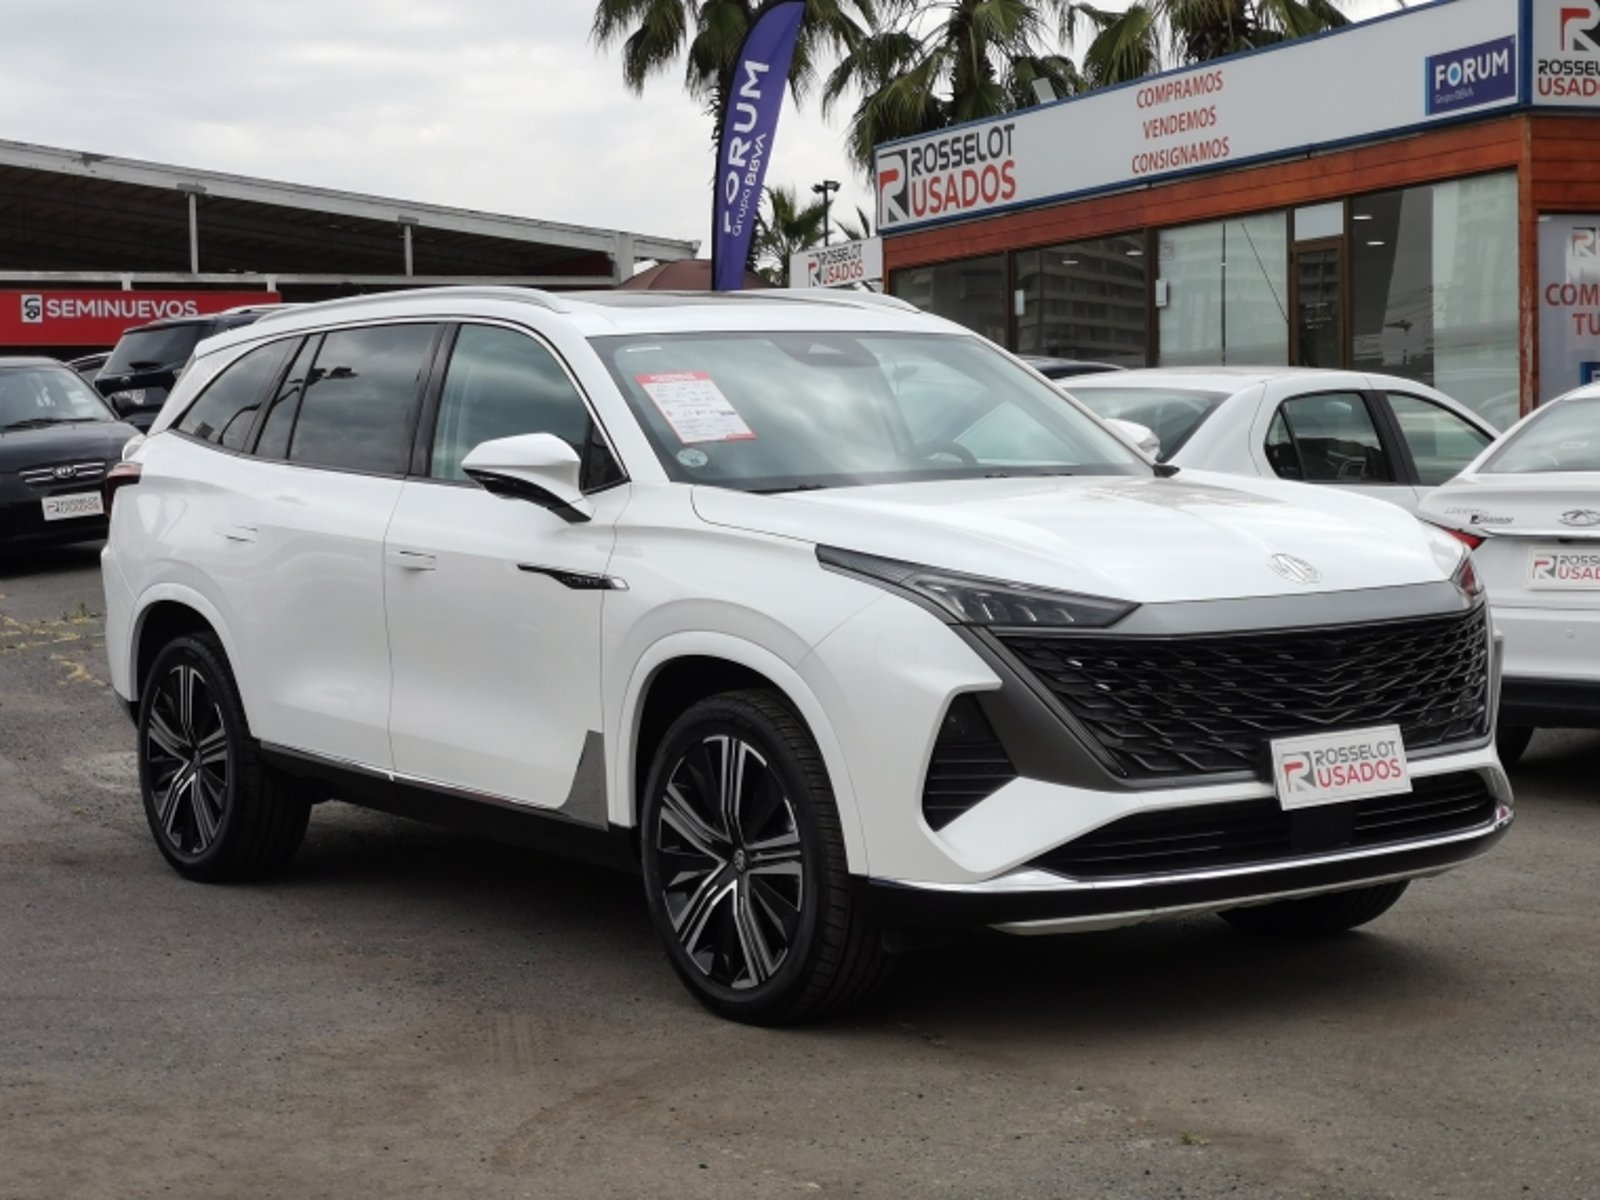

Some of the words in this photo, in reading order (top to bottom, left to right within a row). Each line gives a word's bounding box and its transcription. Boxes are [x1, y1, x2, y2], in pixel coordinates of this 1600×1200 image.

[1435, 48, 1508, 90] FORUM
[1538, 77, 1600, 97] USAD
[1136, 70, 1224, 109] COMPRAMOS
[1143, 105, 1217, 139] VENDEMOS
[911, 123, 1015, 177] ROSSELOT
[1132, 136, 1230, 174] CONSIGNAMOS
[732, 189, 752, 237] Grupo
[745, 132, 767, 186] BBVA
[911, 160, 1016, 217] USADOS
[46, 299, 198, 319] SEMINUEVOS
[1559, 555, 1600, 567] ROSS
[1314, 741, 1397, 767] ROSSELOT
[1317, 758, 1402, 788] USADOS
